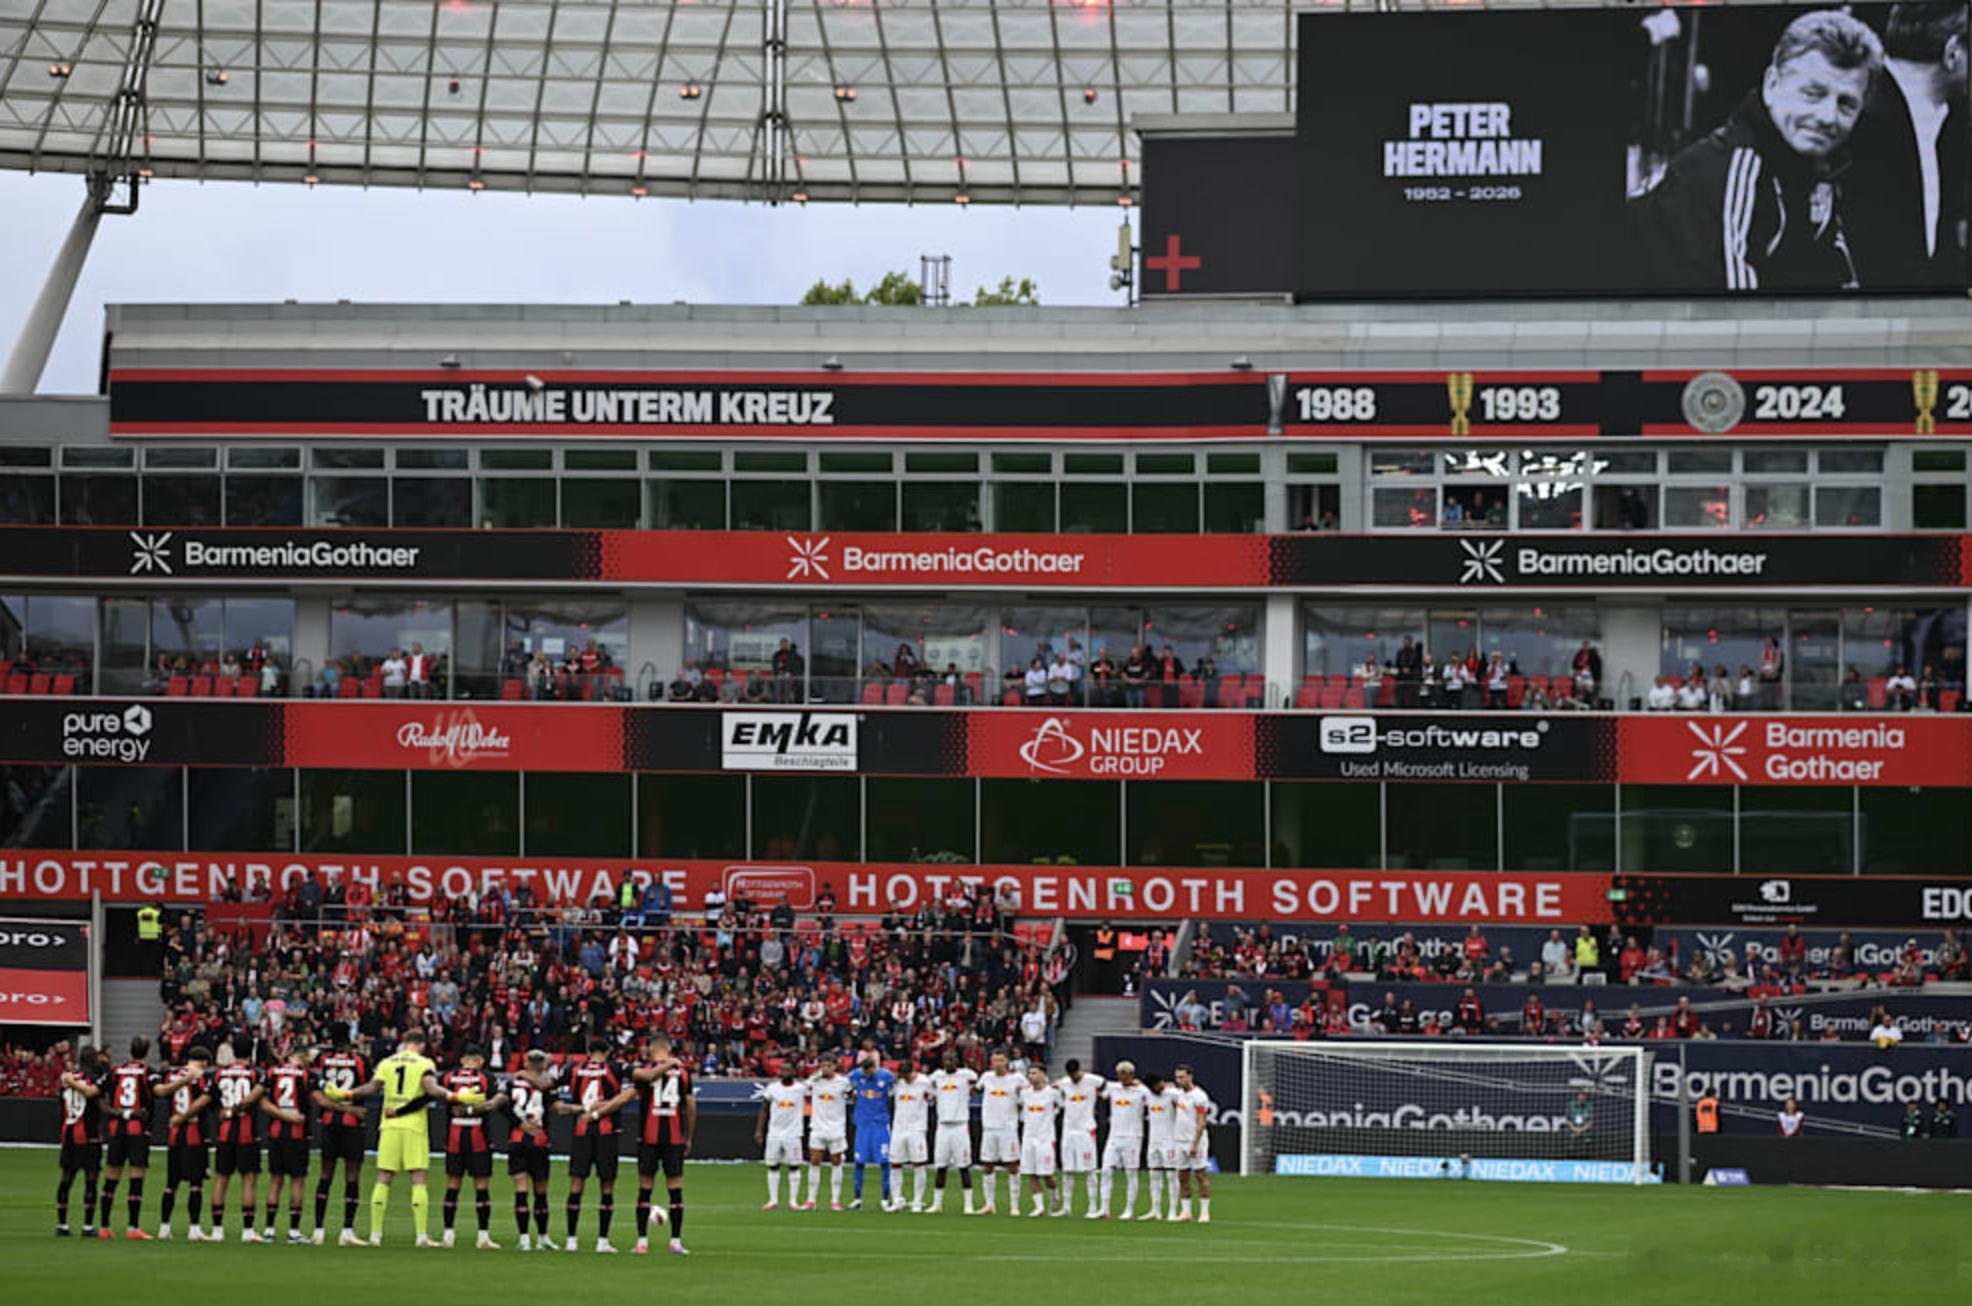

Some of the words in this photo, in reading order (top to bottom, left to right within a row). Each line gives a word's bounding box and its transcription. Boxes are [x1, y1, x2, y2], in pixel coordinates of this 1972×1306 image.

[1409, 103, 1511, 138] PETER
[1383, 139, 1543, 177] HERMANN
[421, 384, 566, 421] TRÄUME
[572, 391, 712, 423] UNTERM
[719, 392, 834, 423] KREUZ
[1296, 387, 1375, 420] 1988
[1480, 387, 1560, 420] 1993
[1755, 385, 1846, 418] 2024
[1947, 385, 1972, 419] 2
[185, 541, 420, 567] BarmeniaGothaer
[843, 546, 1085, 573] BarmeniaGothaer
[1518, 549, 1767, 575] BarmeniaGothaer
[63, 713, 121, 737] pure
[1766, 722, 1905, 749] Barmenia
[63, 737, 151, 762] energy
[1090, 728, 1203, 755] NIEDAX
[1089, 756, 1165, 775] GROUP
[1340, 761, 1380, 778] Used
[1384, 761, 1453, 778] Microsoft
[1459, 762, 1529, 781] Licensing
[1765, 754, 1883, 780] Gothaer
[1272, 879, 1563, 917] SOFTWARE
[119, 1077, 137, 1107] 3
[219, 1077, 251, 1108] 30
[277, 1077, 295, 1107] 2
[394, 1065, 407, 1095] 1
[581, 1079, 601, 1110] 4
[651, 1077, 680, 1109] 14
[1653, 1063, 1972, 1105] BarmeniaGoth
[511, 1086, 545, 1127] 24
[1279, 1155, 1362, 1174] NIEDAX
[1470, 1160, 1556, 1180] NIEDAX
